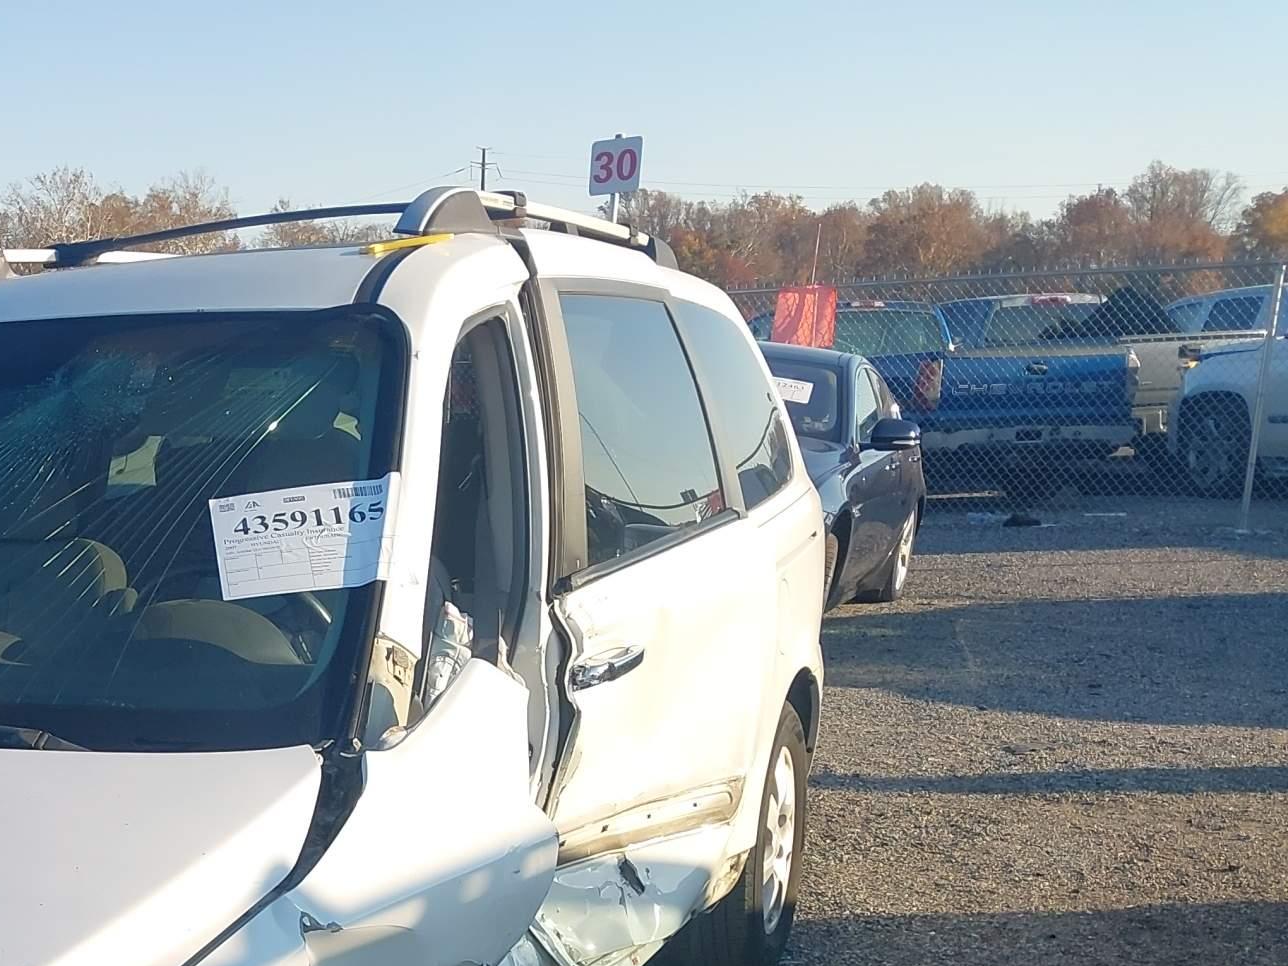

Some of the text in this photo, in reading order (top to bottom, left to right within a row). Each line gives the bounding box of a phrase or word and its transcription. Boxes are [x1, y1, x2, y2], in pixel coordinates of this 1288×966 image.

[593, 148, 637, 184] 30
[951, 382, 1115, 397] CHEVROLET
[233, 500, 385, 536] 43591165
[270, 529, 305, 539] Casualty
